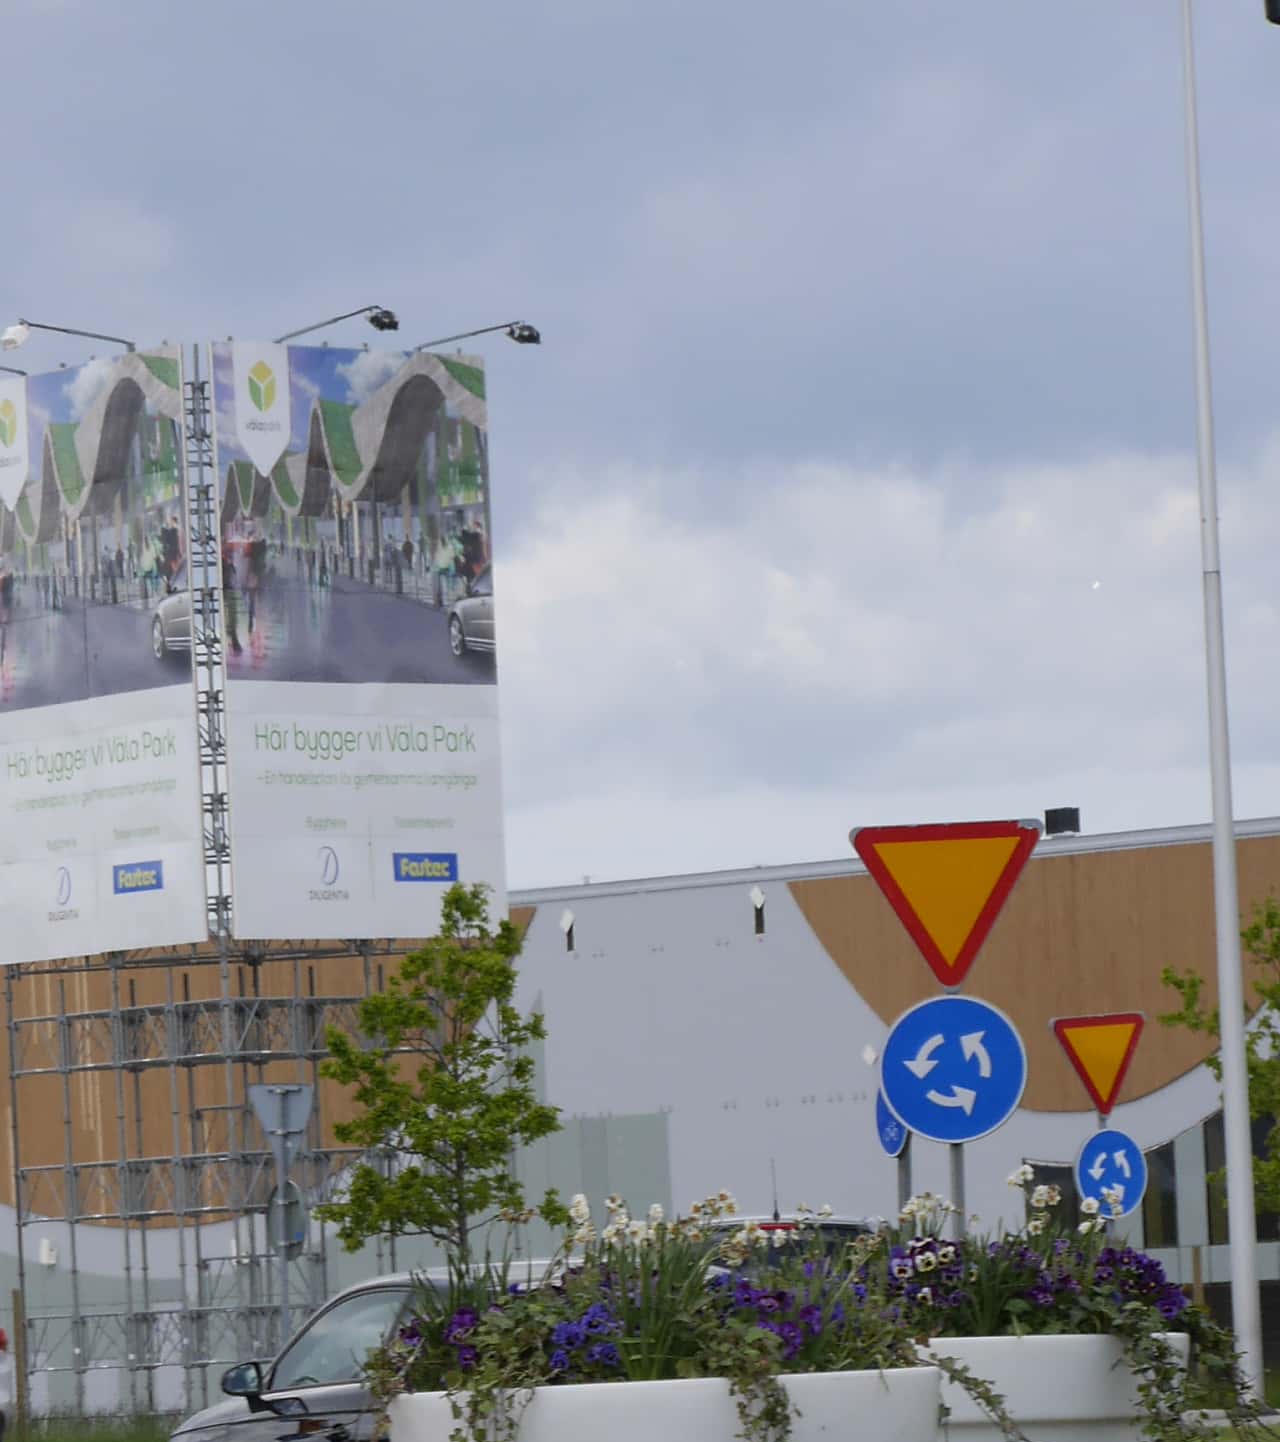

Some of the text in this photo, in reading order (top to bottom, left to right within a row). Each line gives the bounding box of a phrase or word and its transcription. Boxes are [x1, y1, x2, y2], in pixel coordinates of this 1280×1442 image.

[35, 746, 89, 783] bygger
[90, 742, 104, 766] vi
[142, 728, 177, 758] Park
[254, 723, 289, 751] Här
[293, 722, 363, 760] bygger
[366, 724, 382, 751] vi
[432, 724, 477, 752] Park
